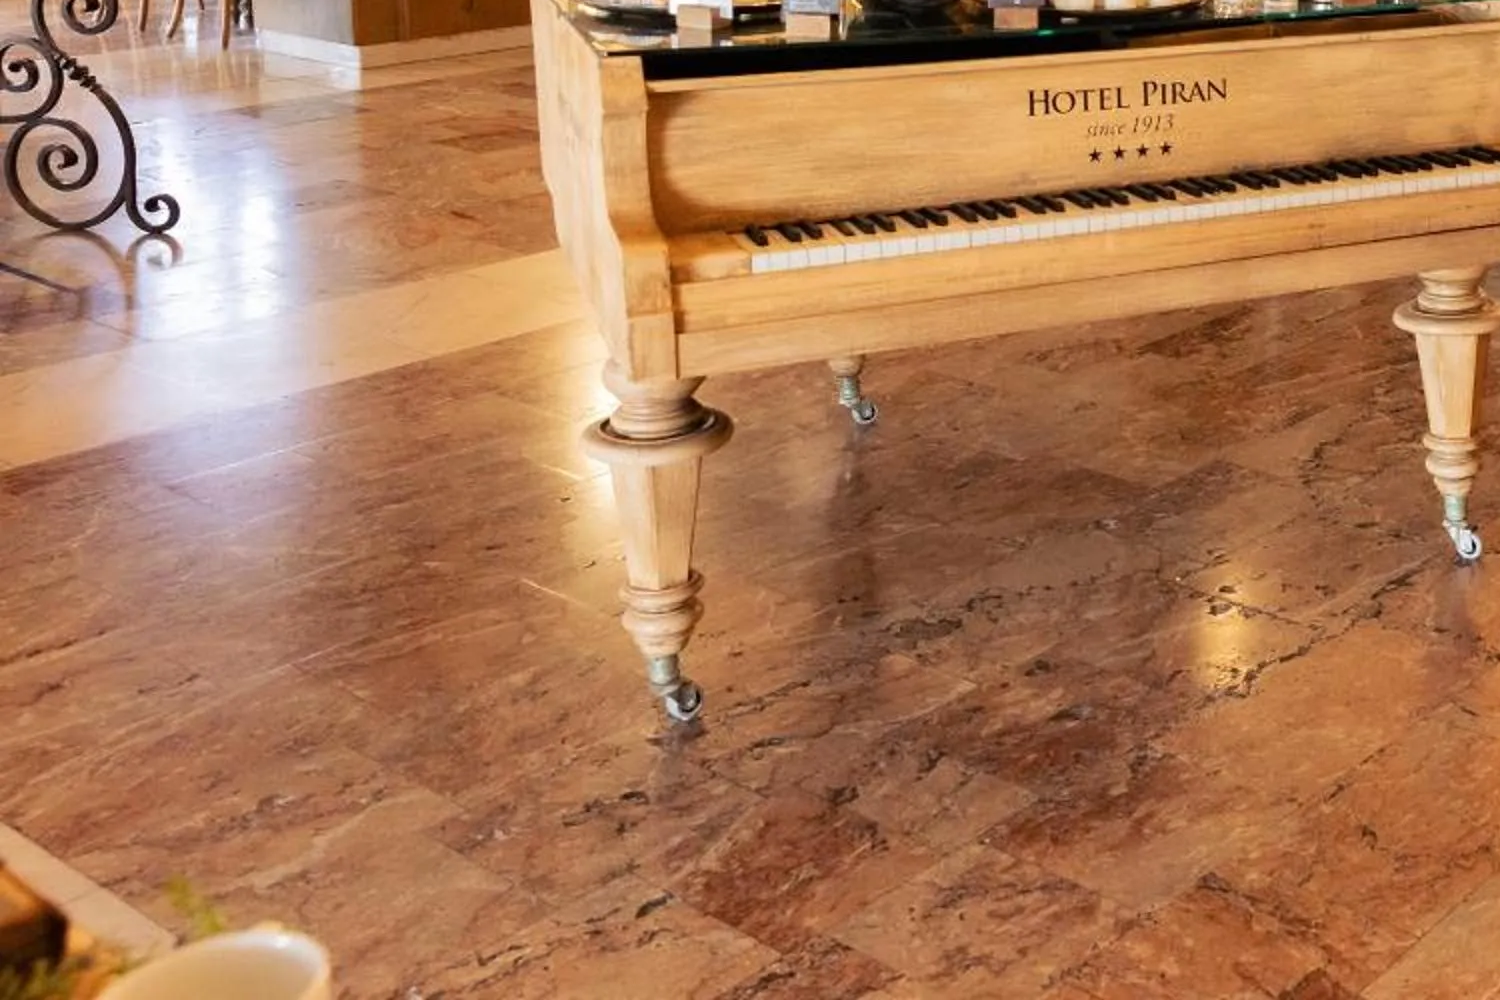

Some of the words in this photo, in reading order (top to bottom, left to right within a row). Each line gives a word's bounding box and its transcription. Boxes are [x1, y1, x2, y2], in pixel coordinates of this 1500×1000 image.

[1027, 86, 1131, 117] HOTEL
[1141, 77, 1228, 108] PIRAN
[1086, 120, 1126, 138] since
[1132, 112, 1175, 135] 1913
